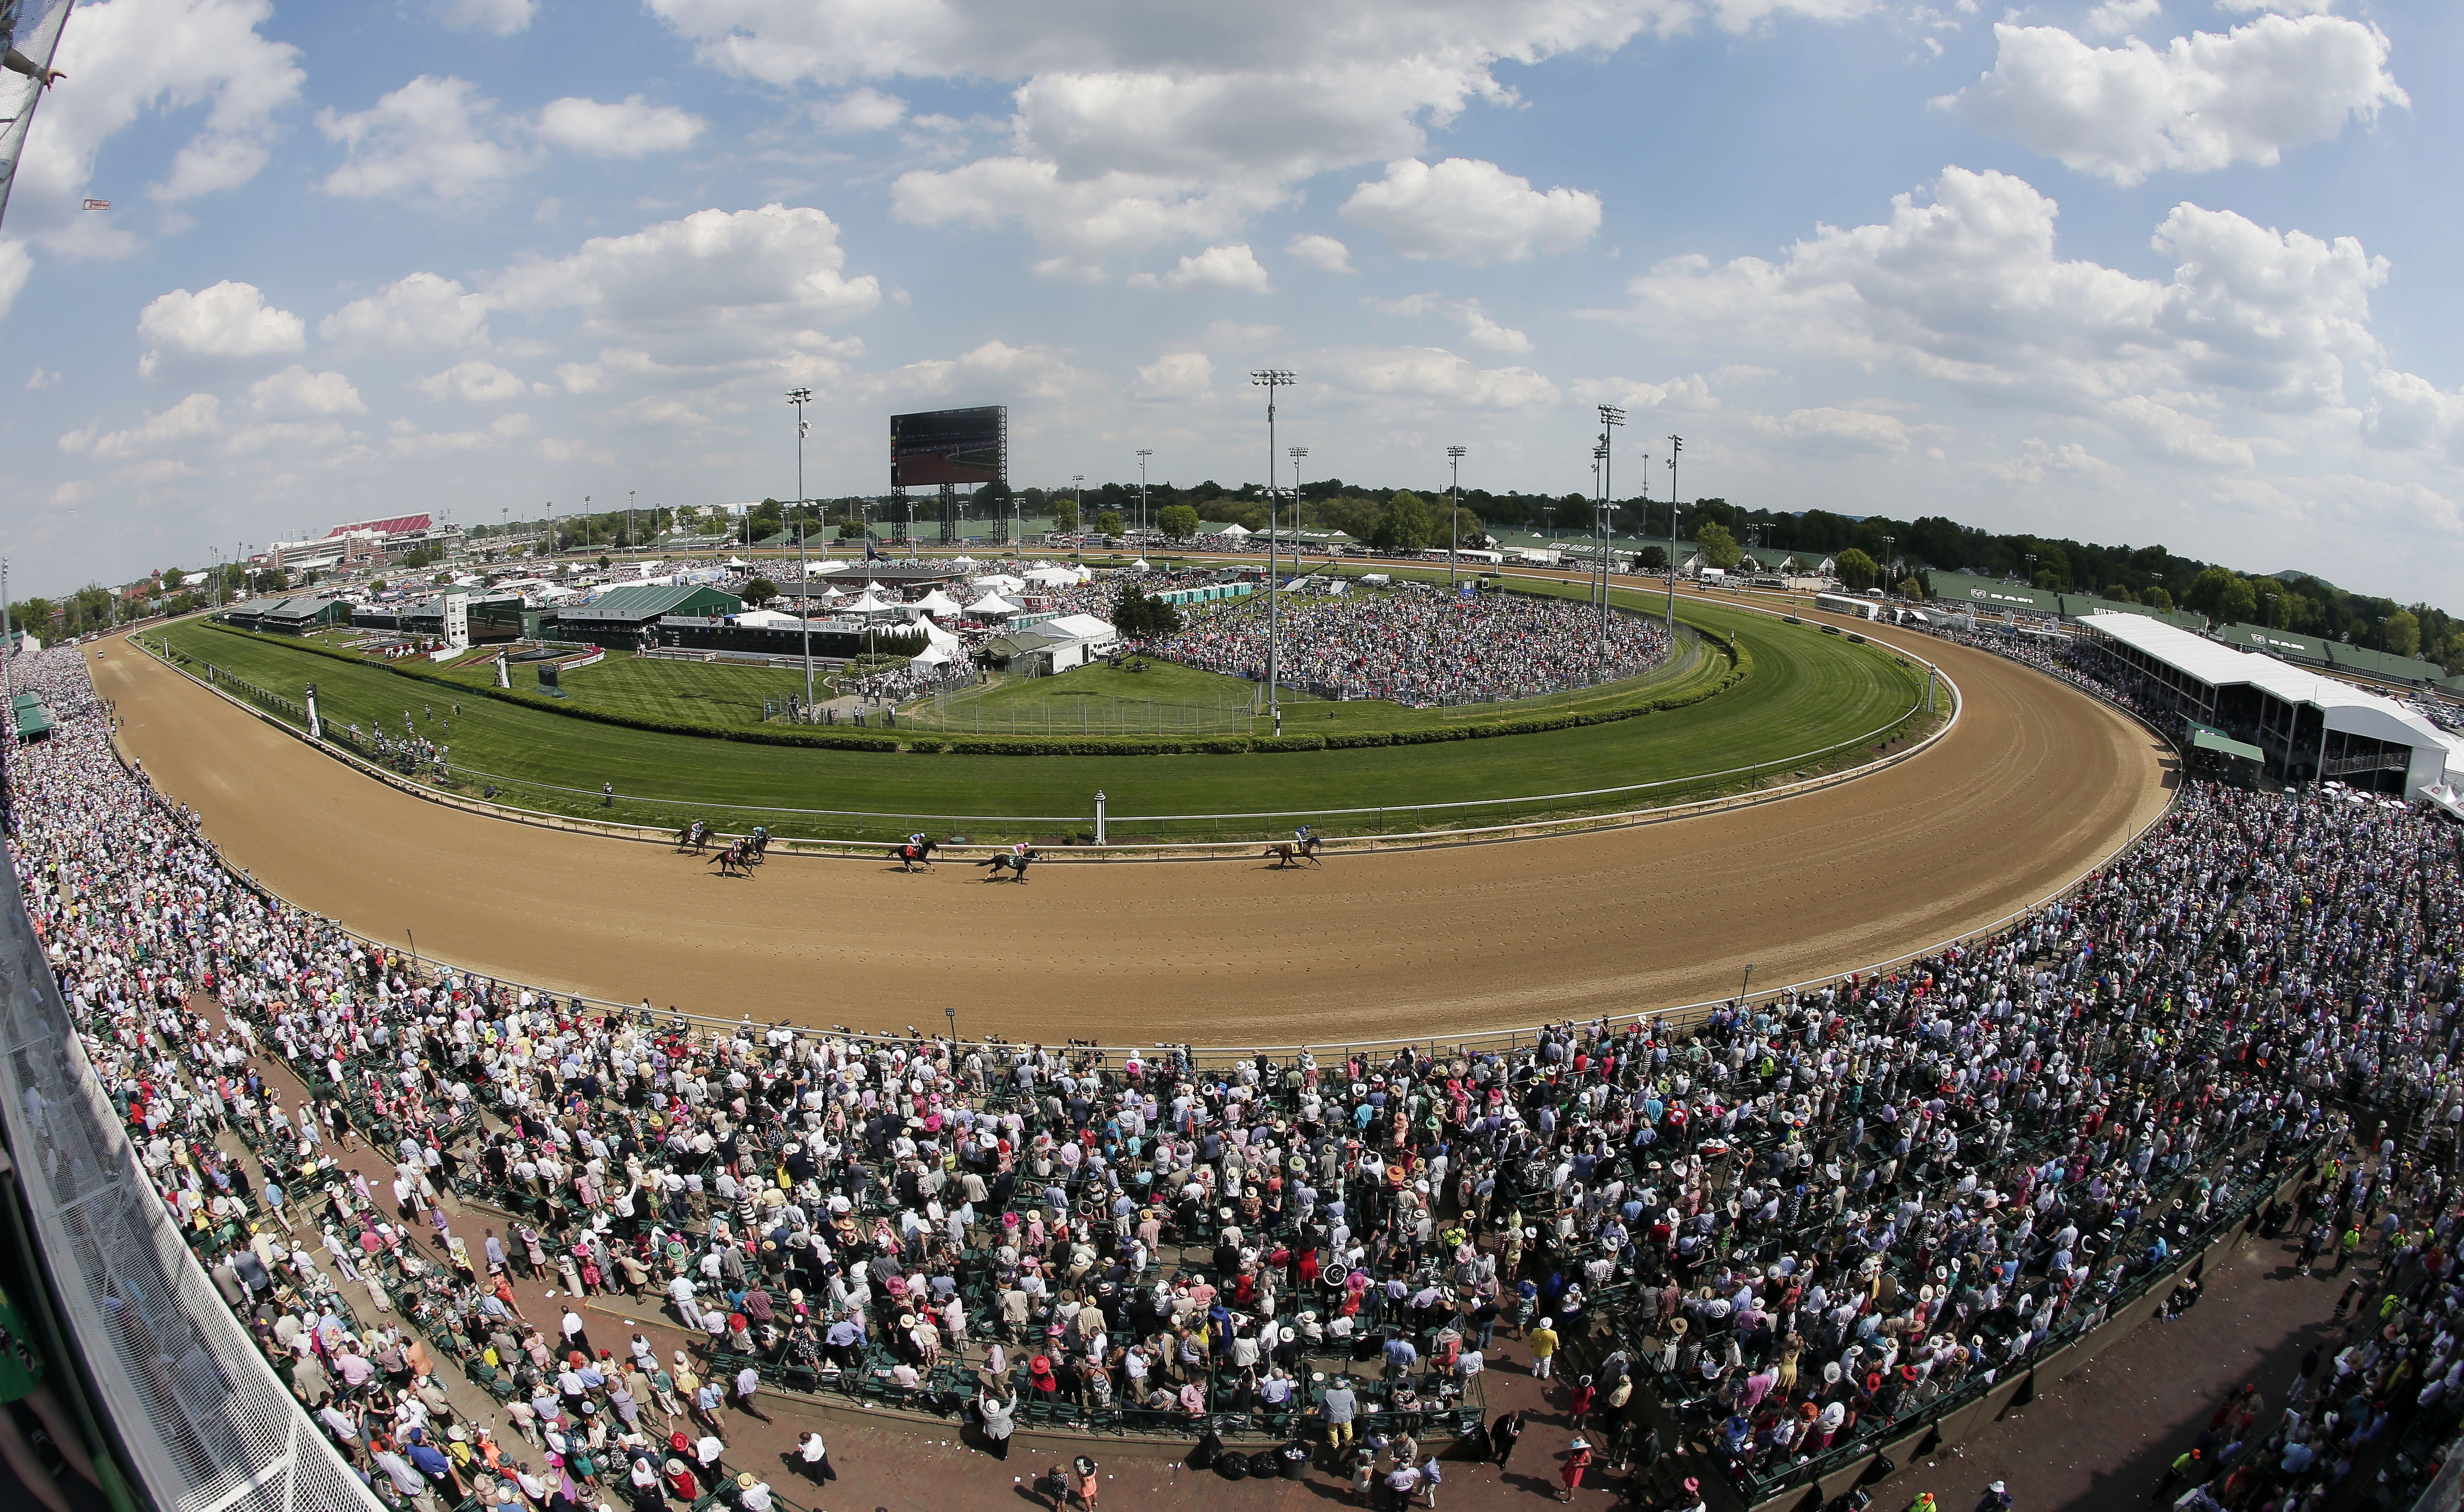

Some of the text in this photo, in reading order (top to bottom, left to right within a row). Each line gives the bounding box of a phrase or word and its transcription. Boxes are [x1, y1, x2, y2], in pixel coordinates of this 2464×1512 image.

[1990, 593, 2034, 604] RAM
[777, 621, 839, 631] Longines Kntucky Oaks
[2268, 638, 2305, 650] RAM
